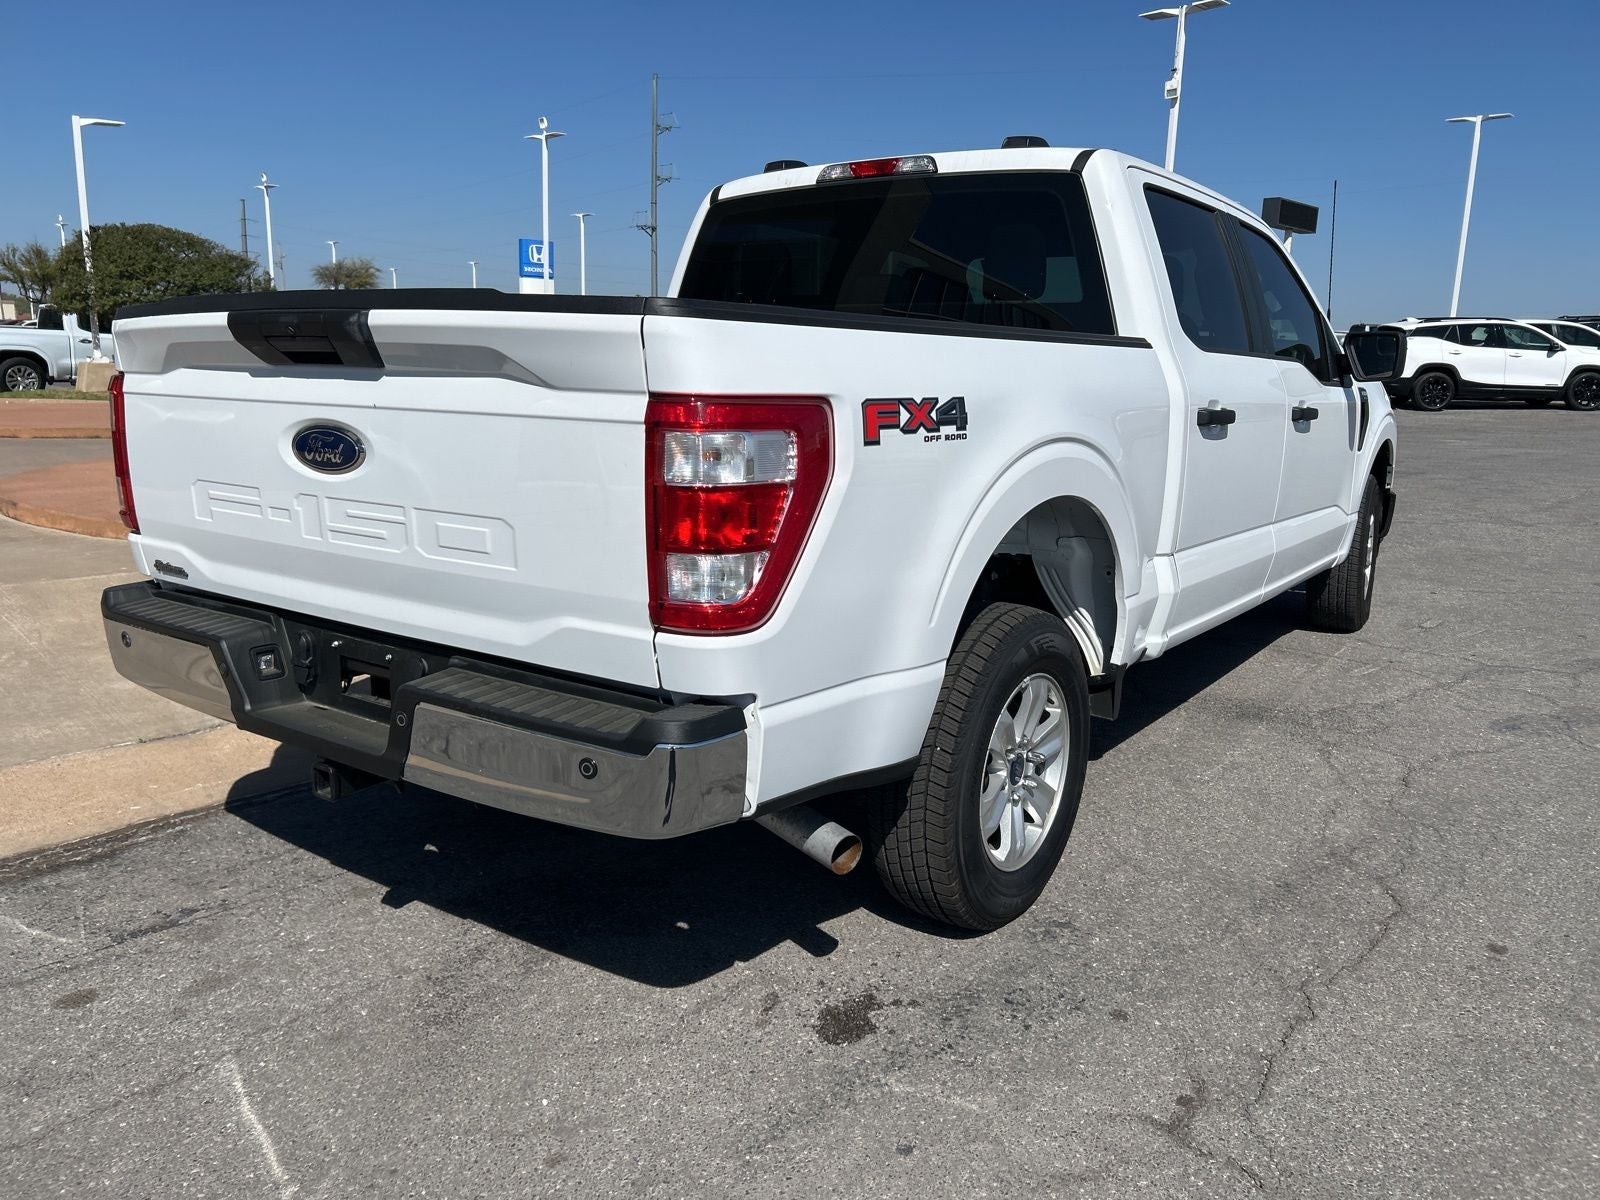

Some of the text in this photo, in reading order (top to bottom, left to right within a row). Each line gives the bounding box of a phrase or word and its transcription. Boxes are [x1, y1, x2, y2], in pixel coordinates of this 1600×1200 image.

[524, 266, 553, 274] HONA
[861, 396, 968, 447] FX4
[305, 433, 344, 463] Ford
[924, 433, 968, 443] OFF ROAD
[191, 478, 517, 571] F-150
